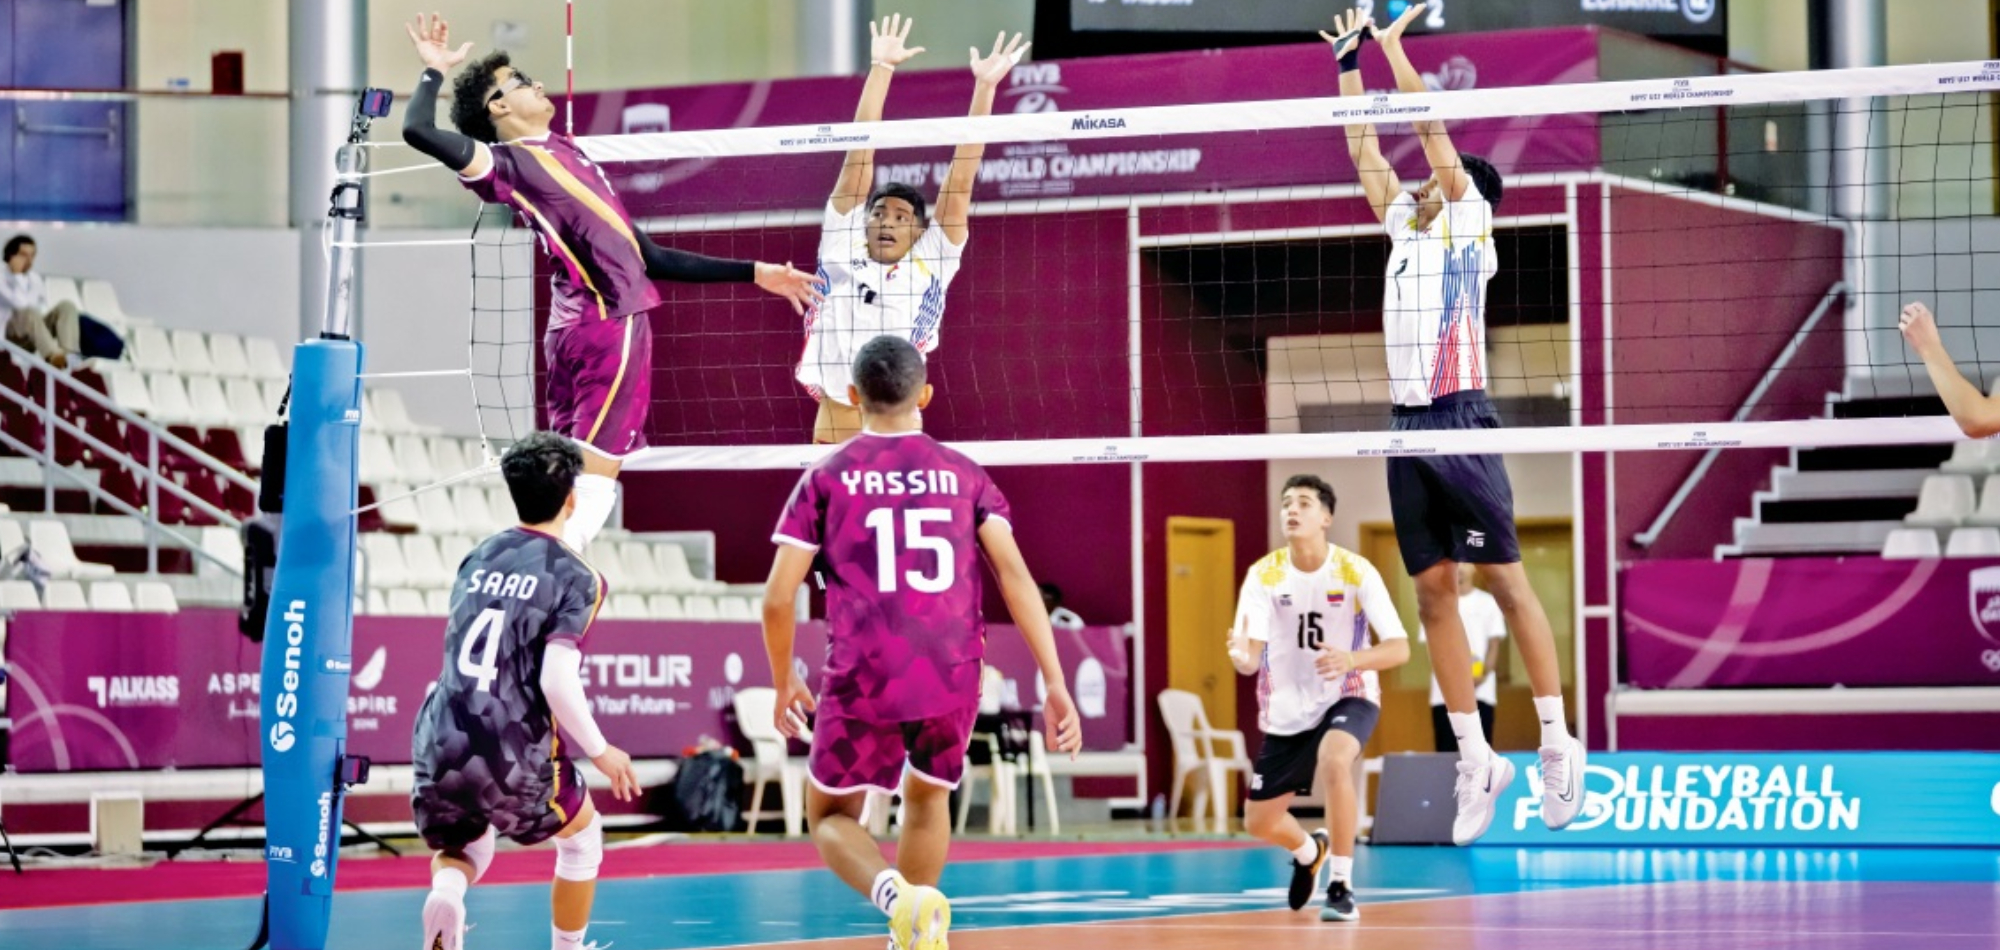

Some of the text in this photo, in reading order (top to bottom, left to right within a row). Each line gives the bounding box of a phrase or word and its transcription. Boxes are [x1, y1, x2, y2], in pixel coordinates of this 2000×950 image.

[977, 157, 1047, 183] WORLD
[1051, 148, 1201, 179] CHAMPIONSHIP
[841, 470, 958, 495] YASSIN
[865, 507, 955, 593] 15
[467, 569, 538, 599] SAAD
[1297, 611, 1324, 652] 15
[273, 600, 306, 718] Senoh
[457, 608, 506, 692] 4
[109, 675, 179, 700] ALKASS
[207, 673, 261, 694] ASPE
[580, 654, 692, 687] ETOUR
[347, 695, 397, 715] SPIRE
[314, 792, 331, 858] Senoh
